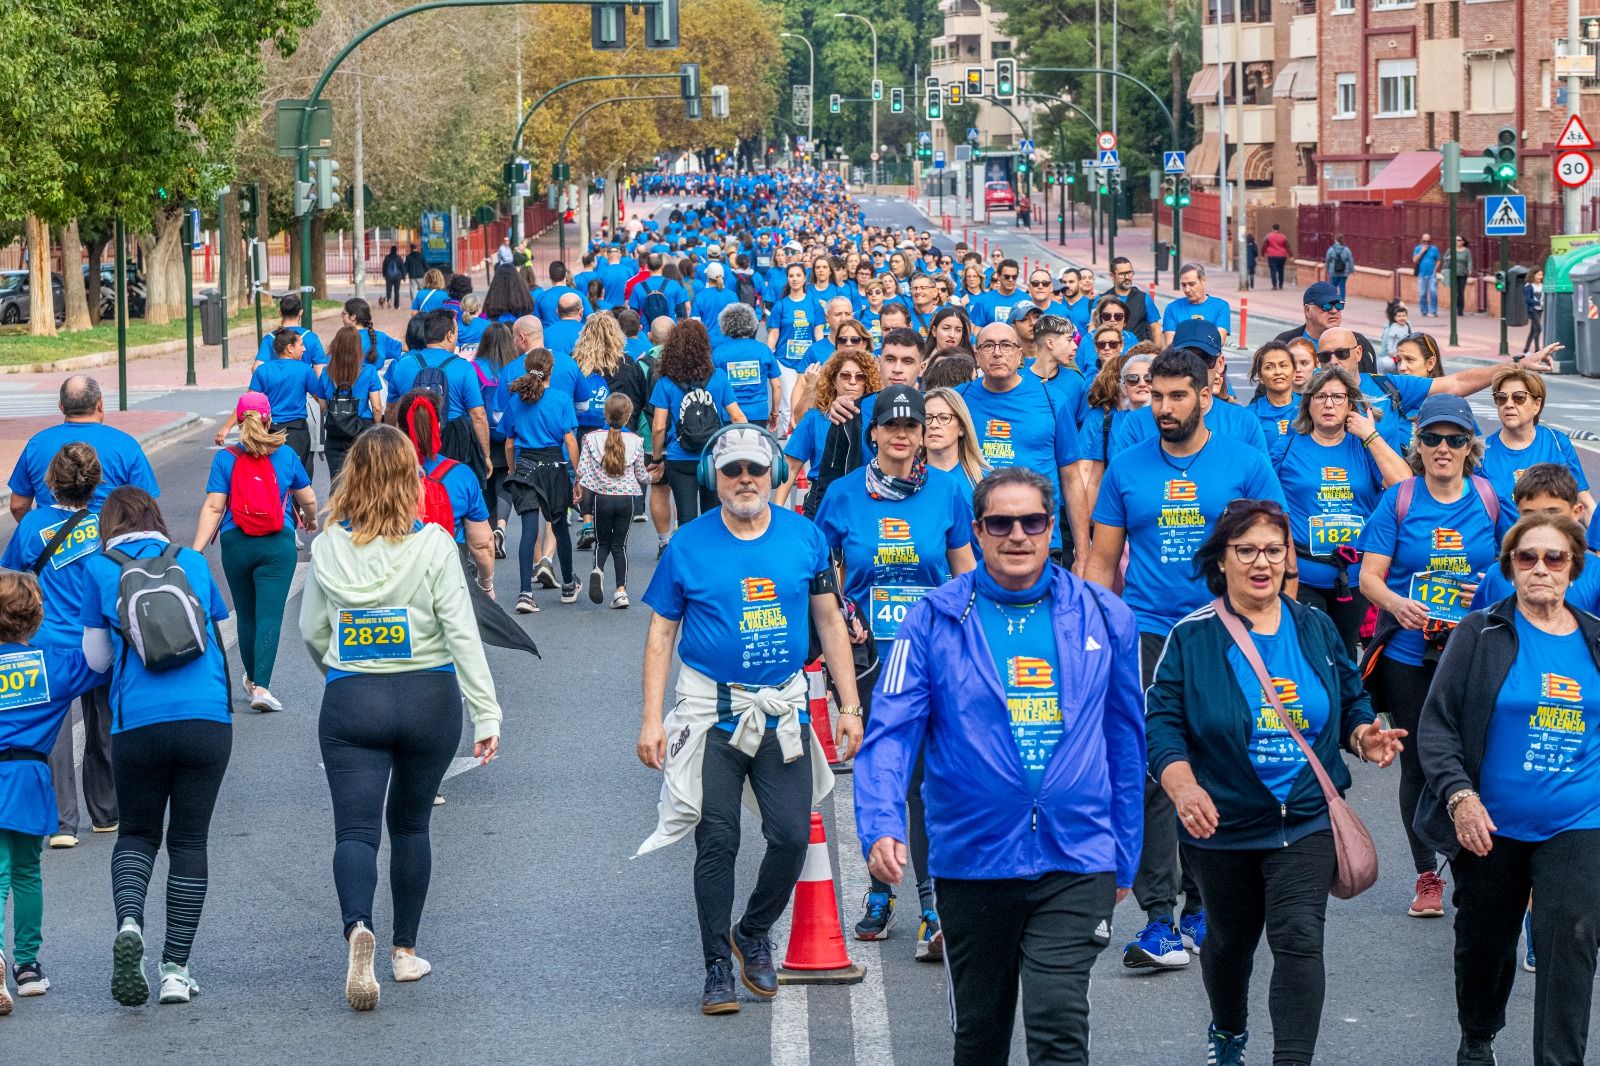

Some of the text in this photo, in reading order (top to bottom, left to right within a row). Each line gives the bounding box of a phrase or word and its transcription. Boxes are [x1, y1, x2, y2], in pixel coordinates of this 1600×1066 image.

[1562, 162, 1584, 175] 30
[731, 369, 757, 378] 1956
[1161, 507, 1200, 517] MUÉVETE
[1158, 515, 1206, 527] X VALENCIA
[1316, 528, 1361, 544] 1821
[878, 544, 915, 557] MUÉVETE
[874, 554, 919, 566] X VALENCIA
[1430, 555, 1467, 567] MUÉVETE
[743, 607, 782, 621] MUÉVETE
[739, 621, 745, 631] X
[748, 616, 787, 630] VALENCIA
[344, 625, 405, 646] 2829
[1007, 695, 1058, 710] MUÉVETE
[1011, 709, 1063, 722] VALENCIA
[1537, 705, 1583, 721] MUÉVETE
[1257, 717, 1262, 728] X
[1529, 715, 1537, 727] X
[1539, 715, 1586, 732] VALENCIA
